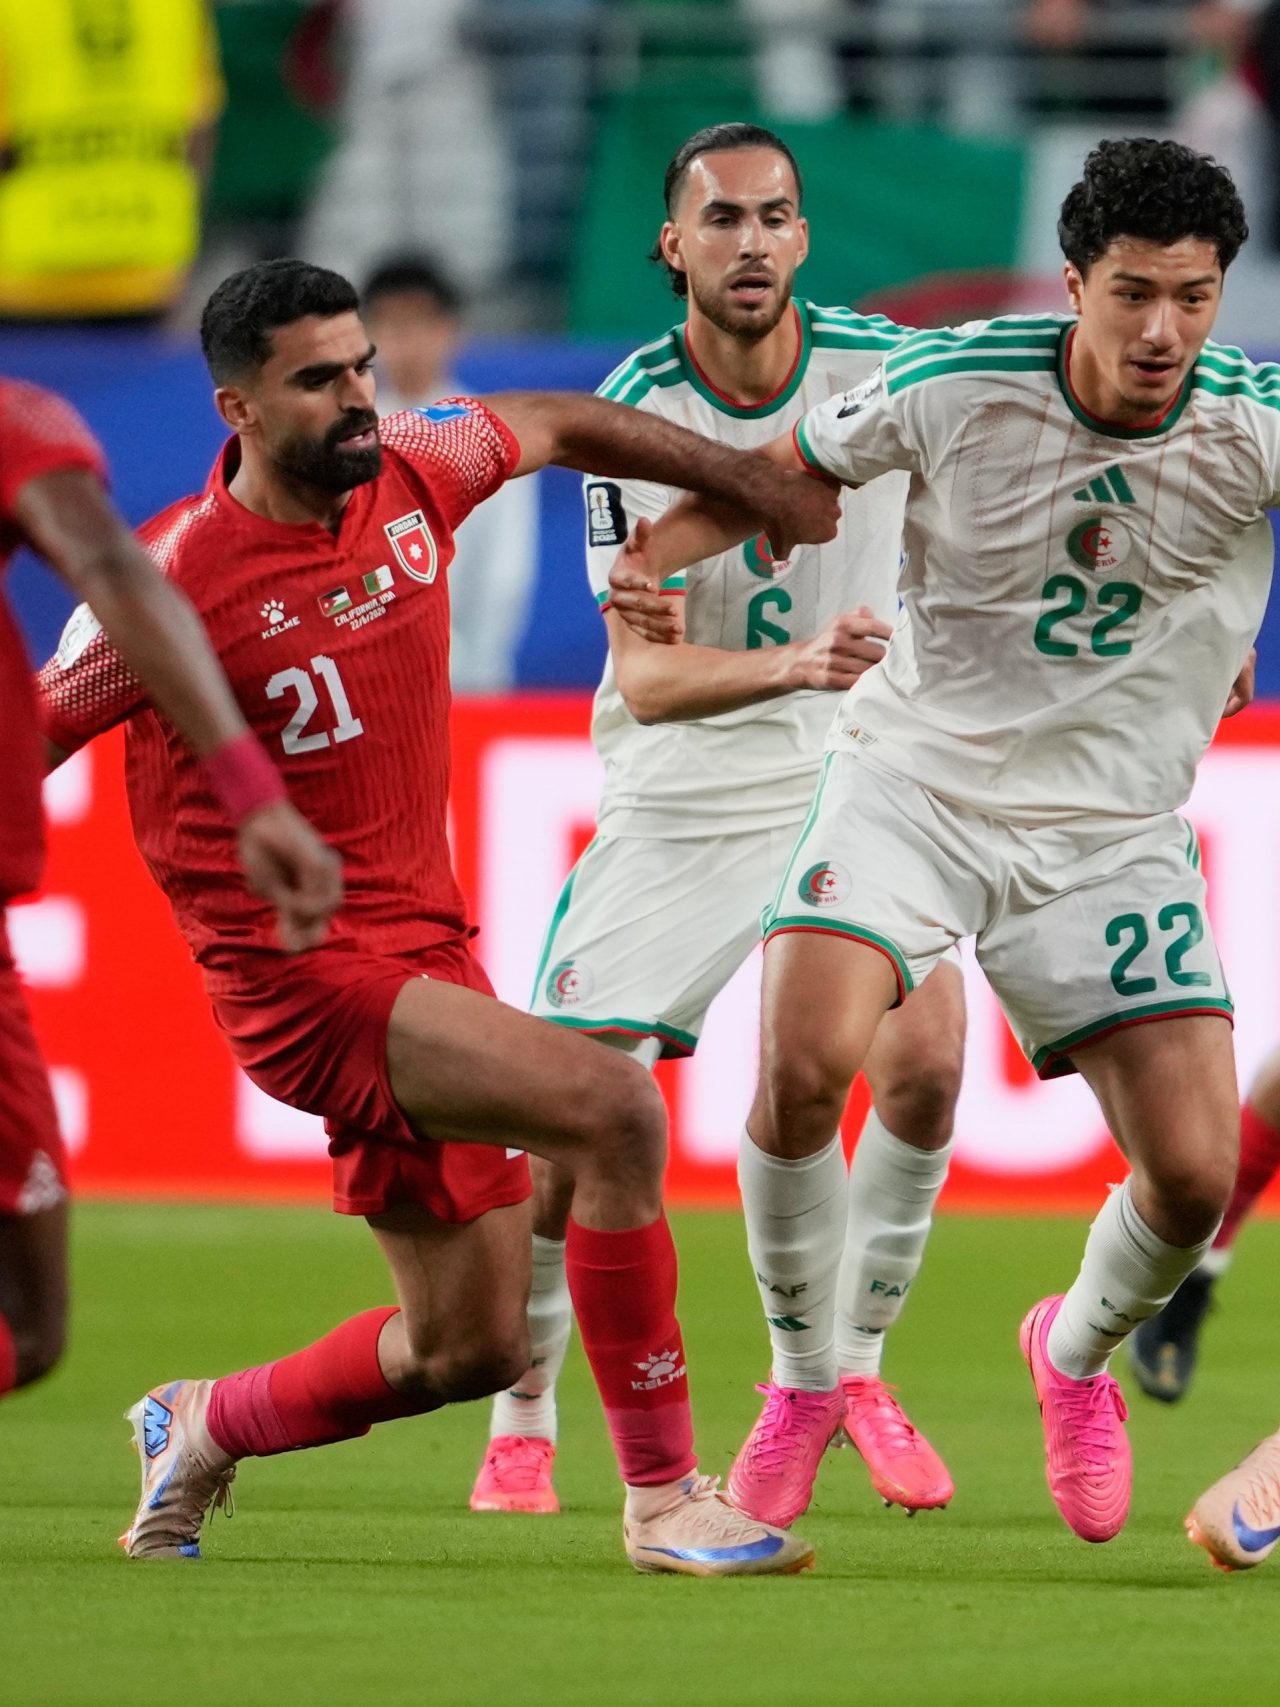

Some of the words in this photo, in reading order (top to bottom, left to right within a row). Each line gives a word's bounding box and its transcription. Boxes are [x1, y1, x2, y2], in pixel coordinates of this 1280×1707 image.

[391, 516, 419, 535] JORDAN
[261, 616, 301, 640] KELME
[379, 590, 397, 605] USA
[746, 586, 792, 651] 6
[1034, 574, 1142, 657] 22
[265, 654, 364, 755] 21
[1105, 901, 1212, 997] 22
